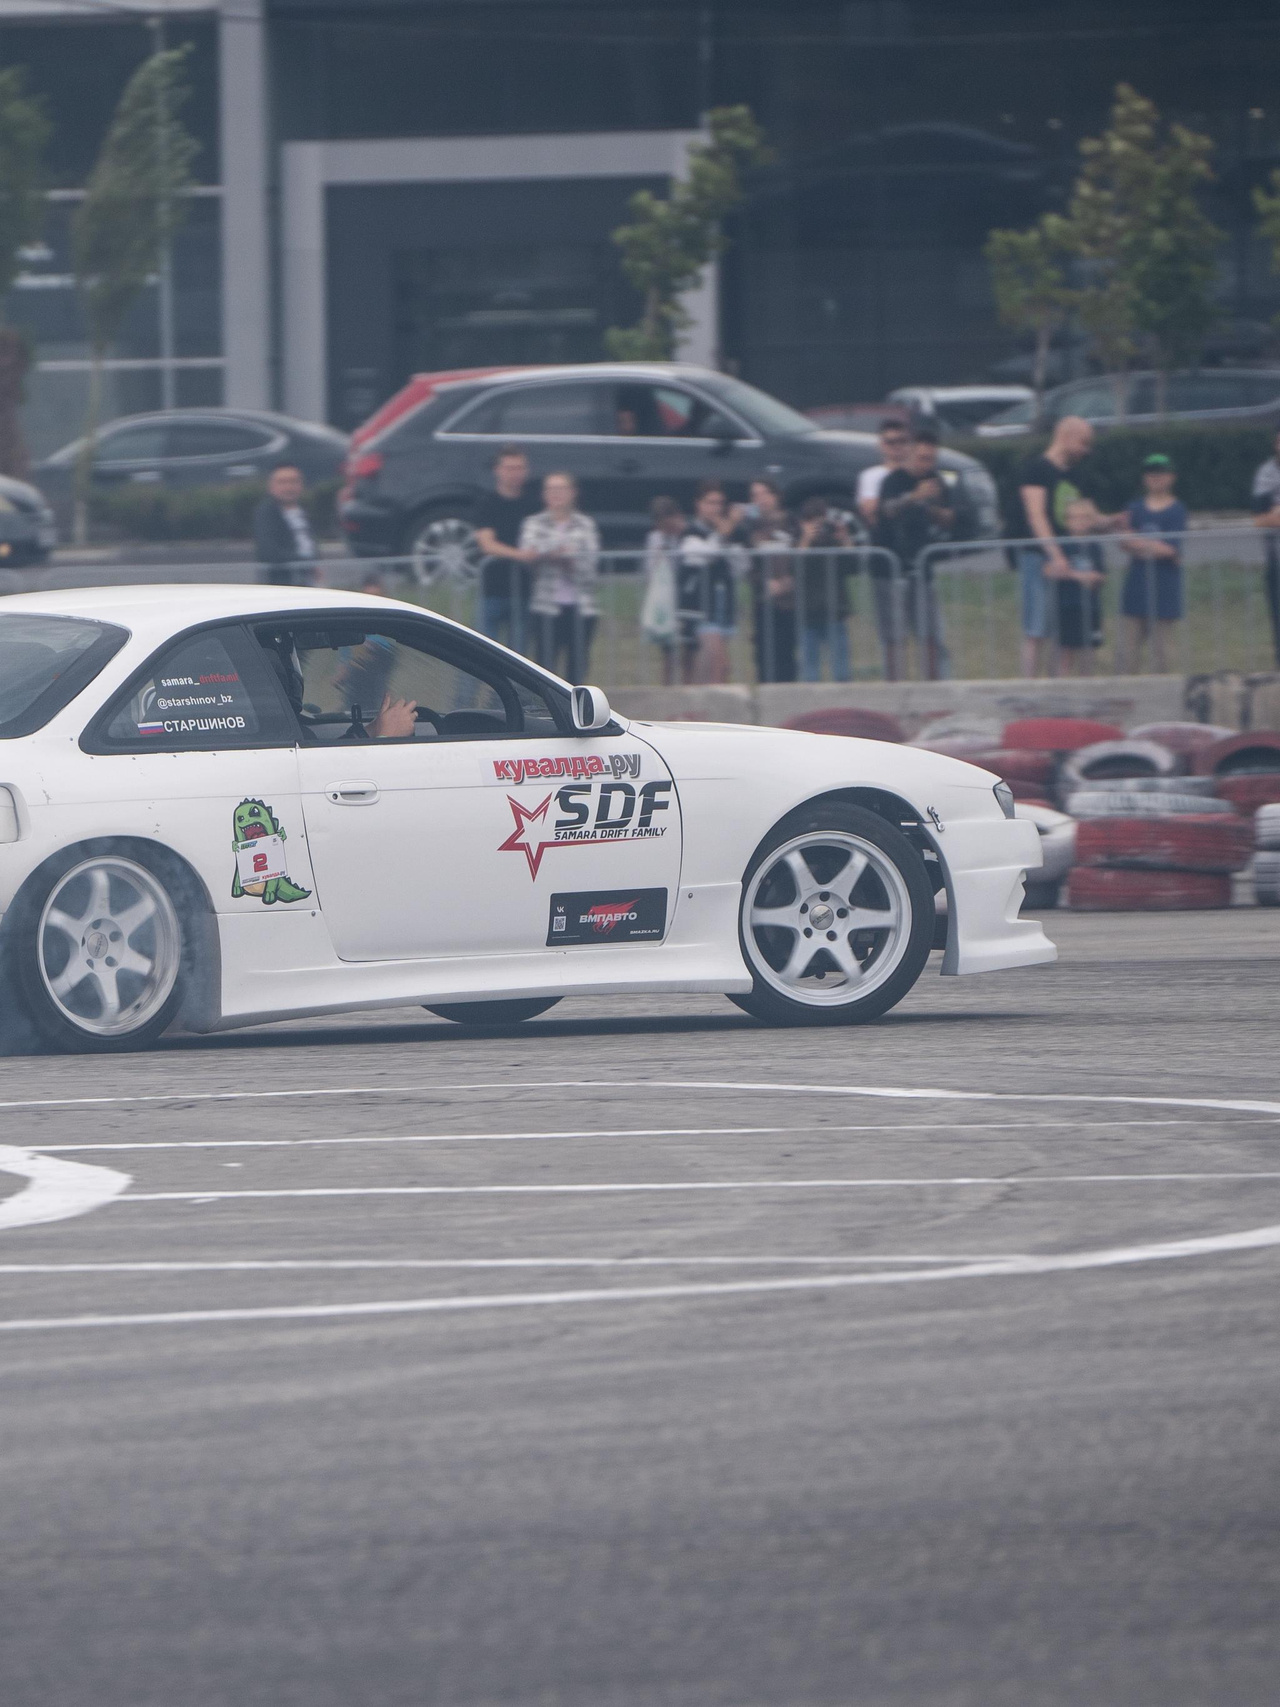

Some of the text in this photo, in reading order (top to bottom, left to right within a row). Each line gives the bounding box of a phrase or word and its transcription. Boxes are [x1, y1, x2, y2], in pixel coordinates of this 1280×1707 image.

[164, 716, 245, 733] СТАРШИНОВ
[493, 754, 641, 784] кувалда.ру
[554, 781, 672, 831] SDF
[554, 827, 667, 840] SAMARA DRIFT FAMILY
[253, 853, 269, 873] 2
[579, 912, 638, 923] ВМПАВТО
